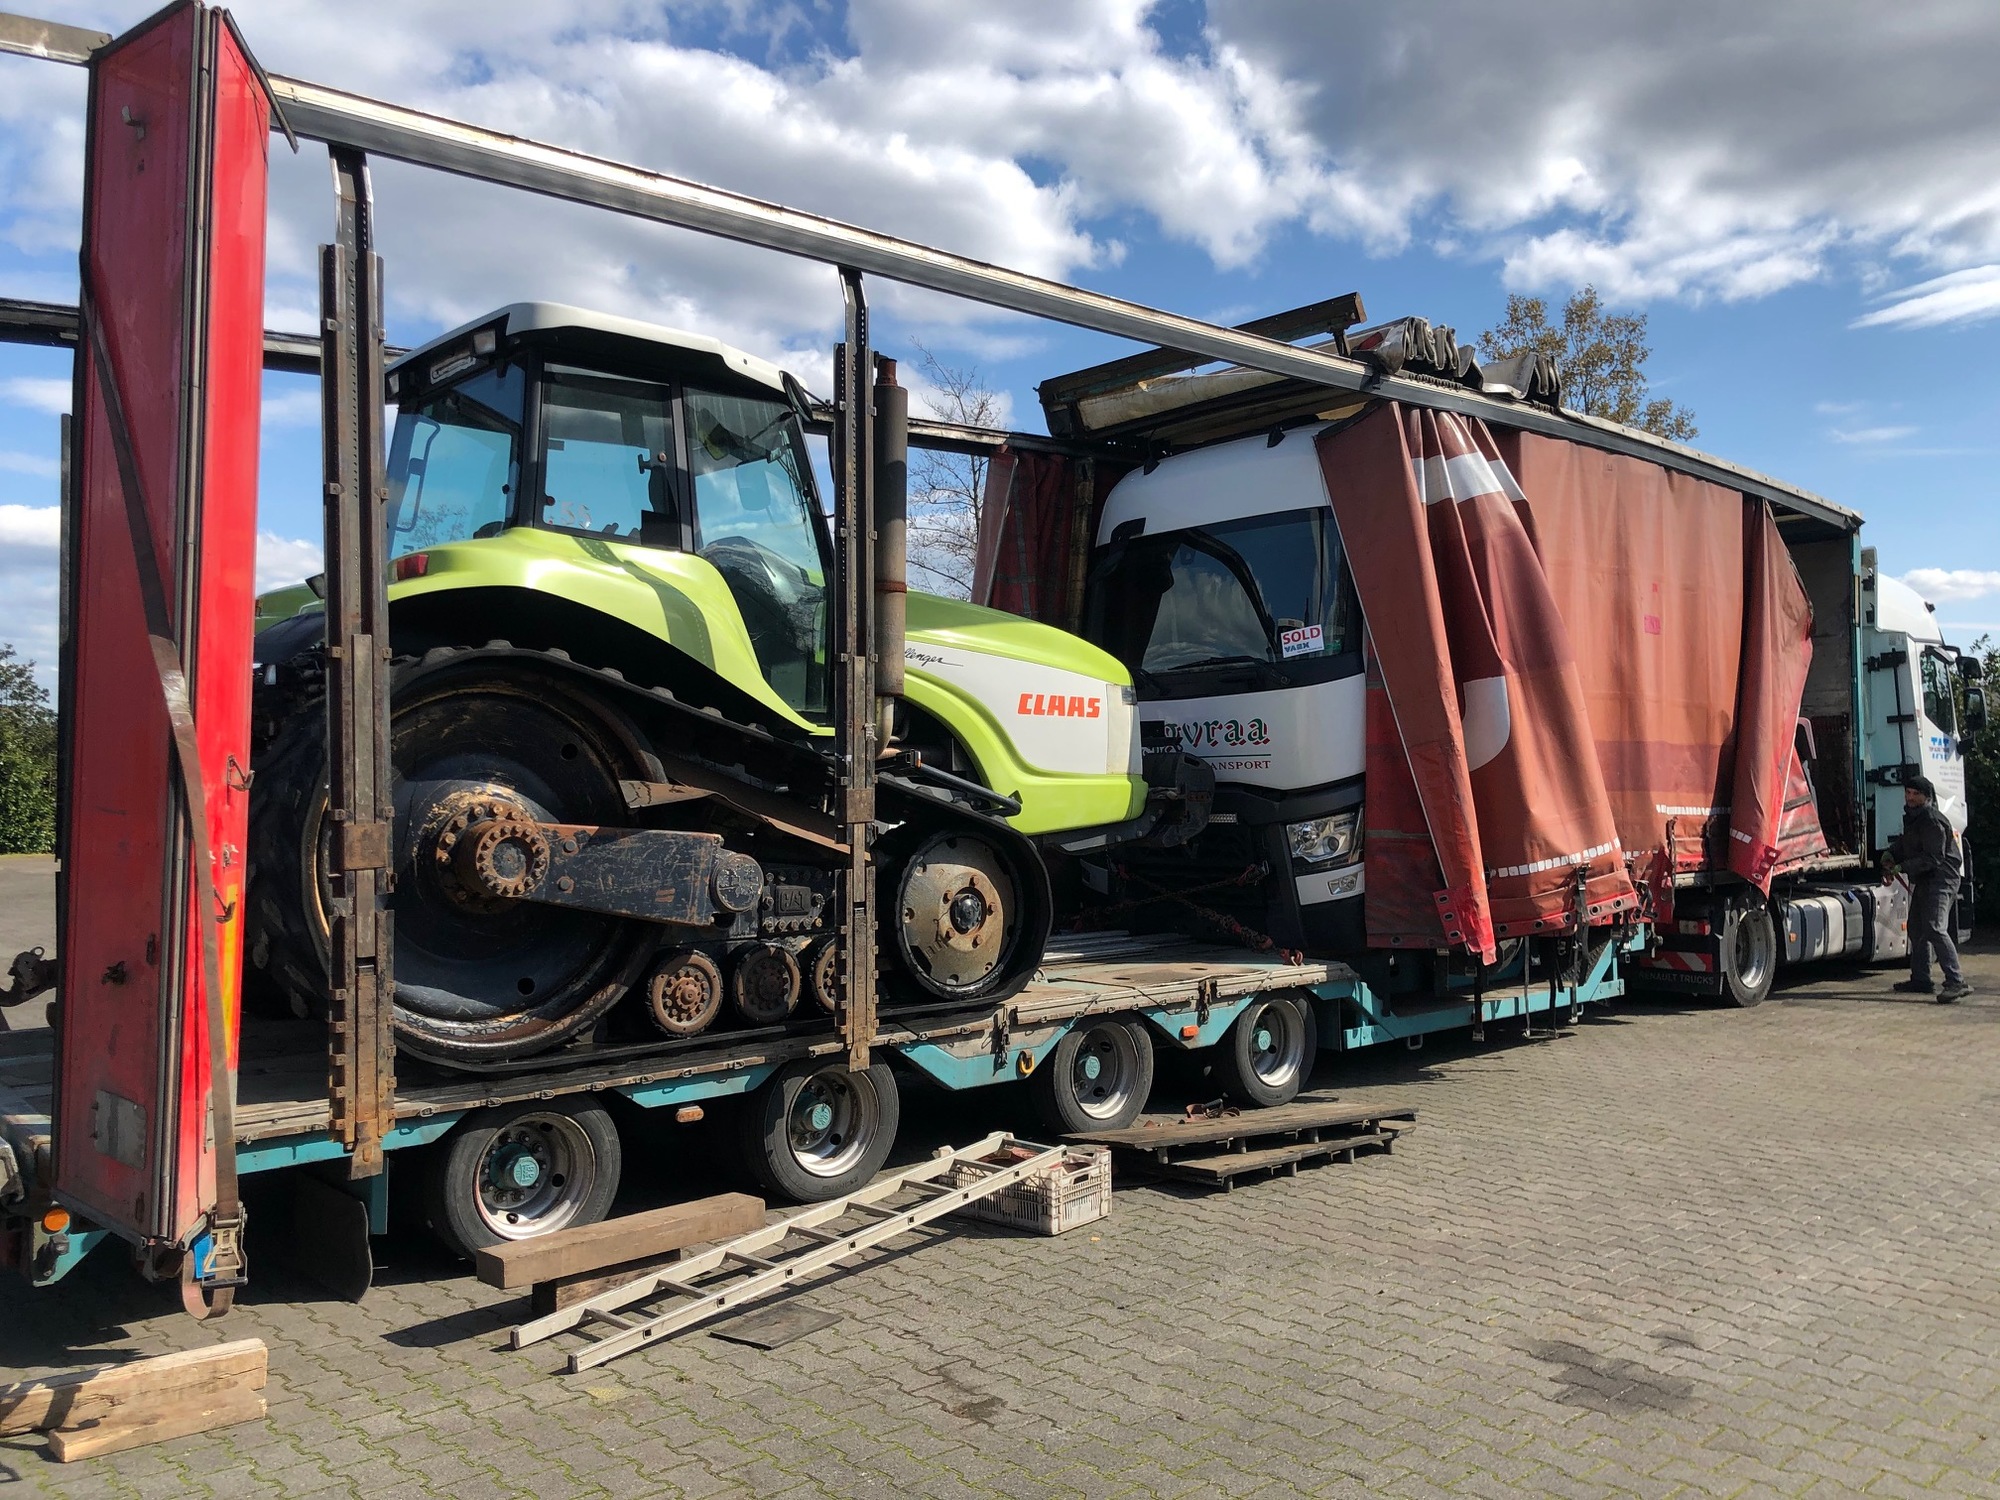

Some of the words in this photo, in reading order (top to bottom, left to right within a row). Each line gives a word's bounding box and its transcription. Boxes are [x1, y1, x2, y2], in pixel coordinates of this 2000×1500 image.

[1283, 627, 1321, 645] SOLD
[905, 647, 964, 667] llenger
[1017, 693, 1101, 718] CLAAS
[1210, 760, 1271, 770] ANSPORT
[1679, 973, 1715, 986] TRUCKS
